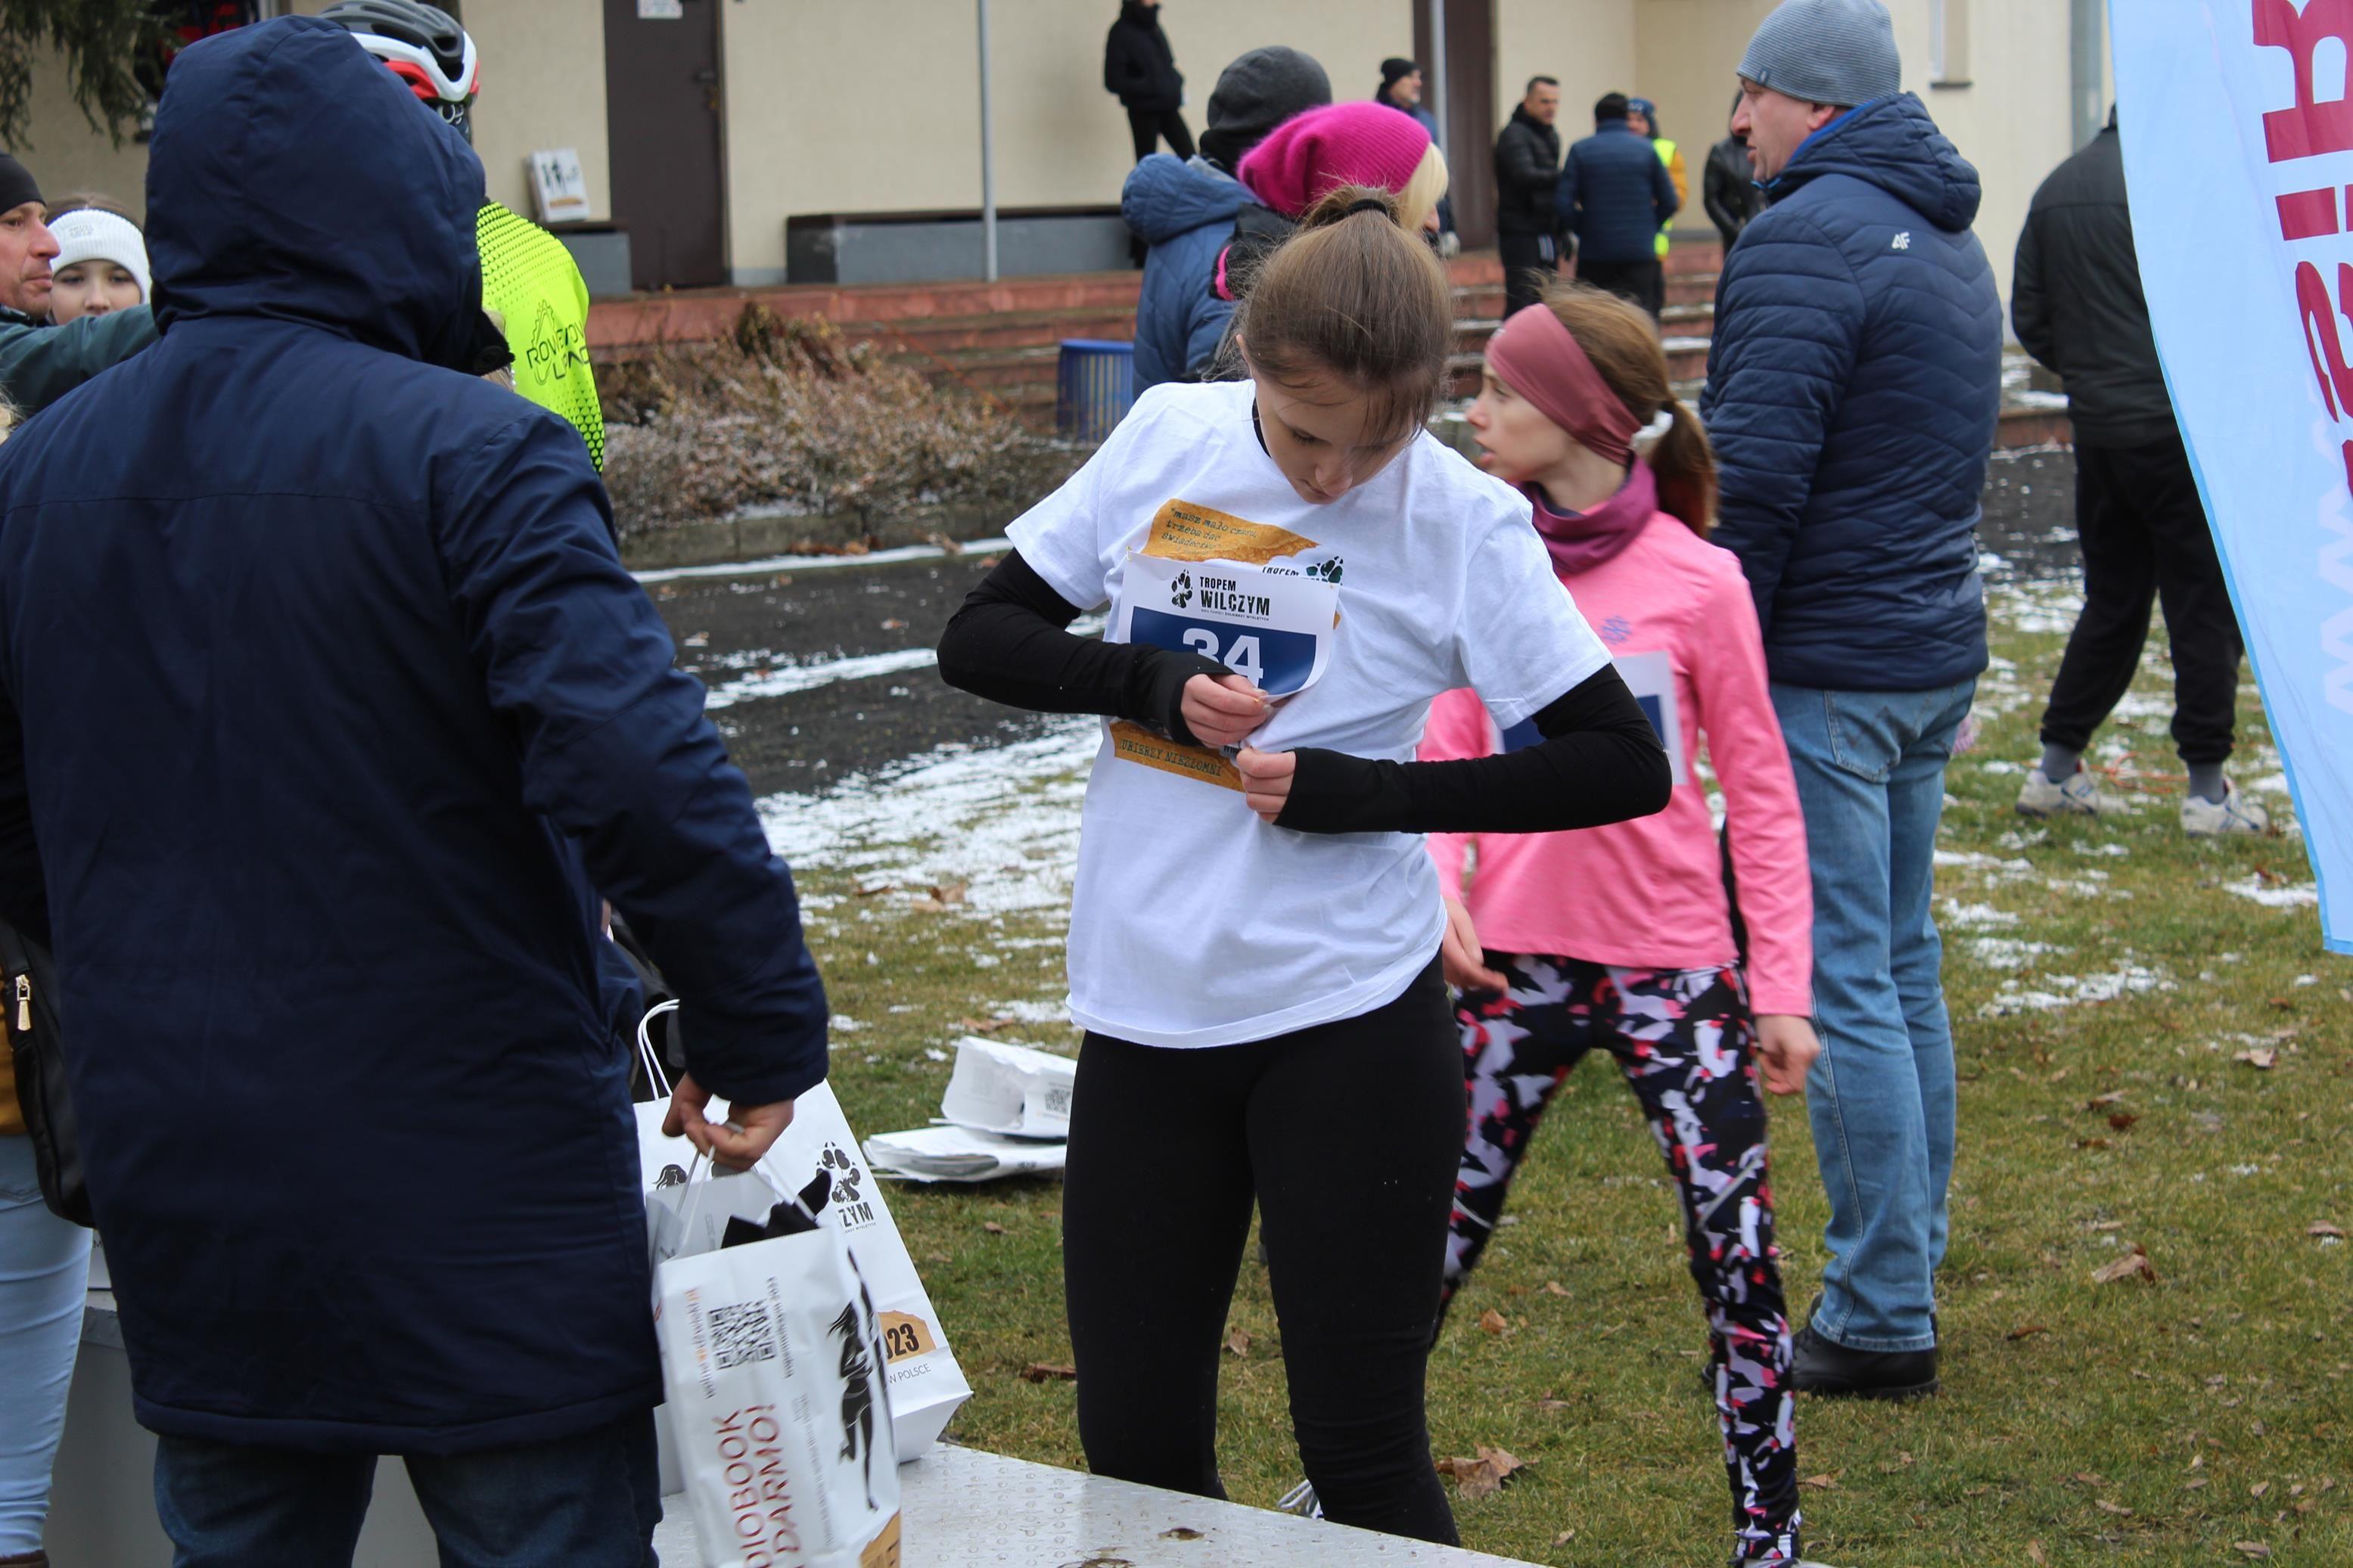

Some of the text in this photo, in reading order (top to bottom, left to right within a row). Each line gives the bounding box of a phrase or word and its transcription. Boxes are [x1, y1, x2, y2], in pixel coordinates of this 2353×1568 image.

[1891, 231, 1910, 250] 4F
[1167, 520, 1201, 536] trzeba
[1200, 576, 1236, 591] TROPEM
[1201, 589, 1270, 616] WILCZYM
[1183, 628, 1264, 688] 34
[897, 1363, 931, 1383] POLSCE
[743, 1403, 802, 1555] DARMO!
